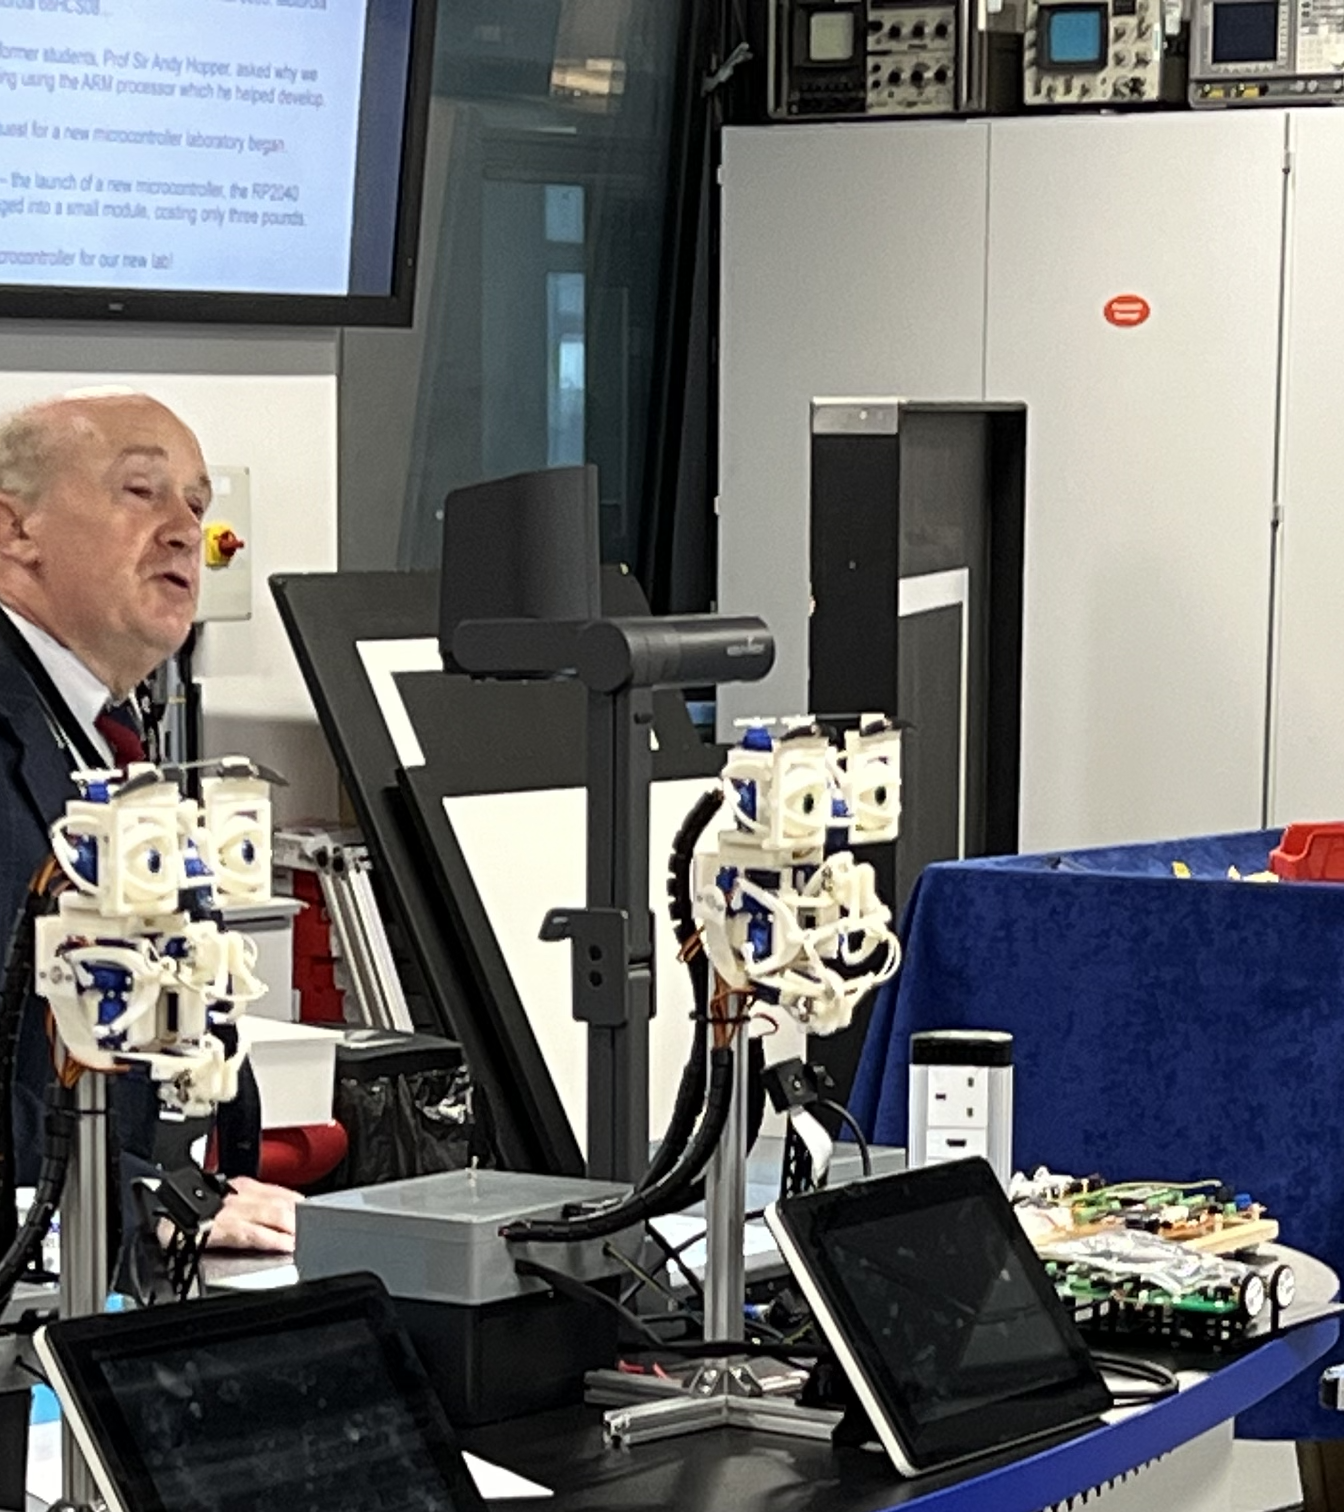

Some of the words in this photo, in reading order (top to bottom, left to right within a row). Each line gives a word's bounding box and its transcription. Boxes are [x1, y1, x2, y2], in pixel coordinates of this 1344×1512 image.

[103, 49, 130, 68] Prof
[132, 51, 149, 70] Sir
[152, 54, 183, 76] Andy
[236, 61, 271, 80] asked
[275, 65, 297, 85] why
[301, 68, 319, 82] we
[21, 73, 55, 93] using
[59, 73, 79, 90] the
[81, 74, 113, 92] ARM
[115, 79, 176, 97] processor
[180, 81, 215, 99] which
[217, 83, 232, 101] he
[235, 85, 276, 105] helped
[31, 120, 49, 139] for
[63, 126, 90, 142] new
[92, 127, 183, 147] microcontroller
[186, 129, 246, 154] laboratory
[11, 171, 31, 189] the
[35, 172, 76, 191] launch
[80, 174, 94, 192] of
[107, 178, 132, 192] new
[229, 182, 248, 200] the
[27, 197, 51, 215] into
[66, 199, 99, 217] small
[155, 205, 197, 226] costing
[200, 206, 225, 227] only
[228, 207, 259, 225] three
[79, 248, 95, 267] for
[99, 253, 120, 268] our
[122, 254, 148, 269] new
